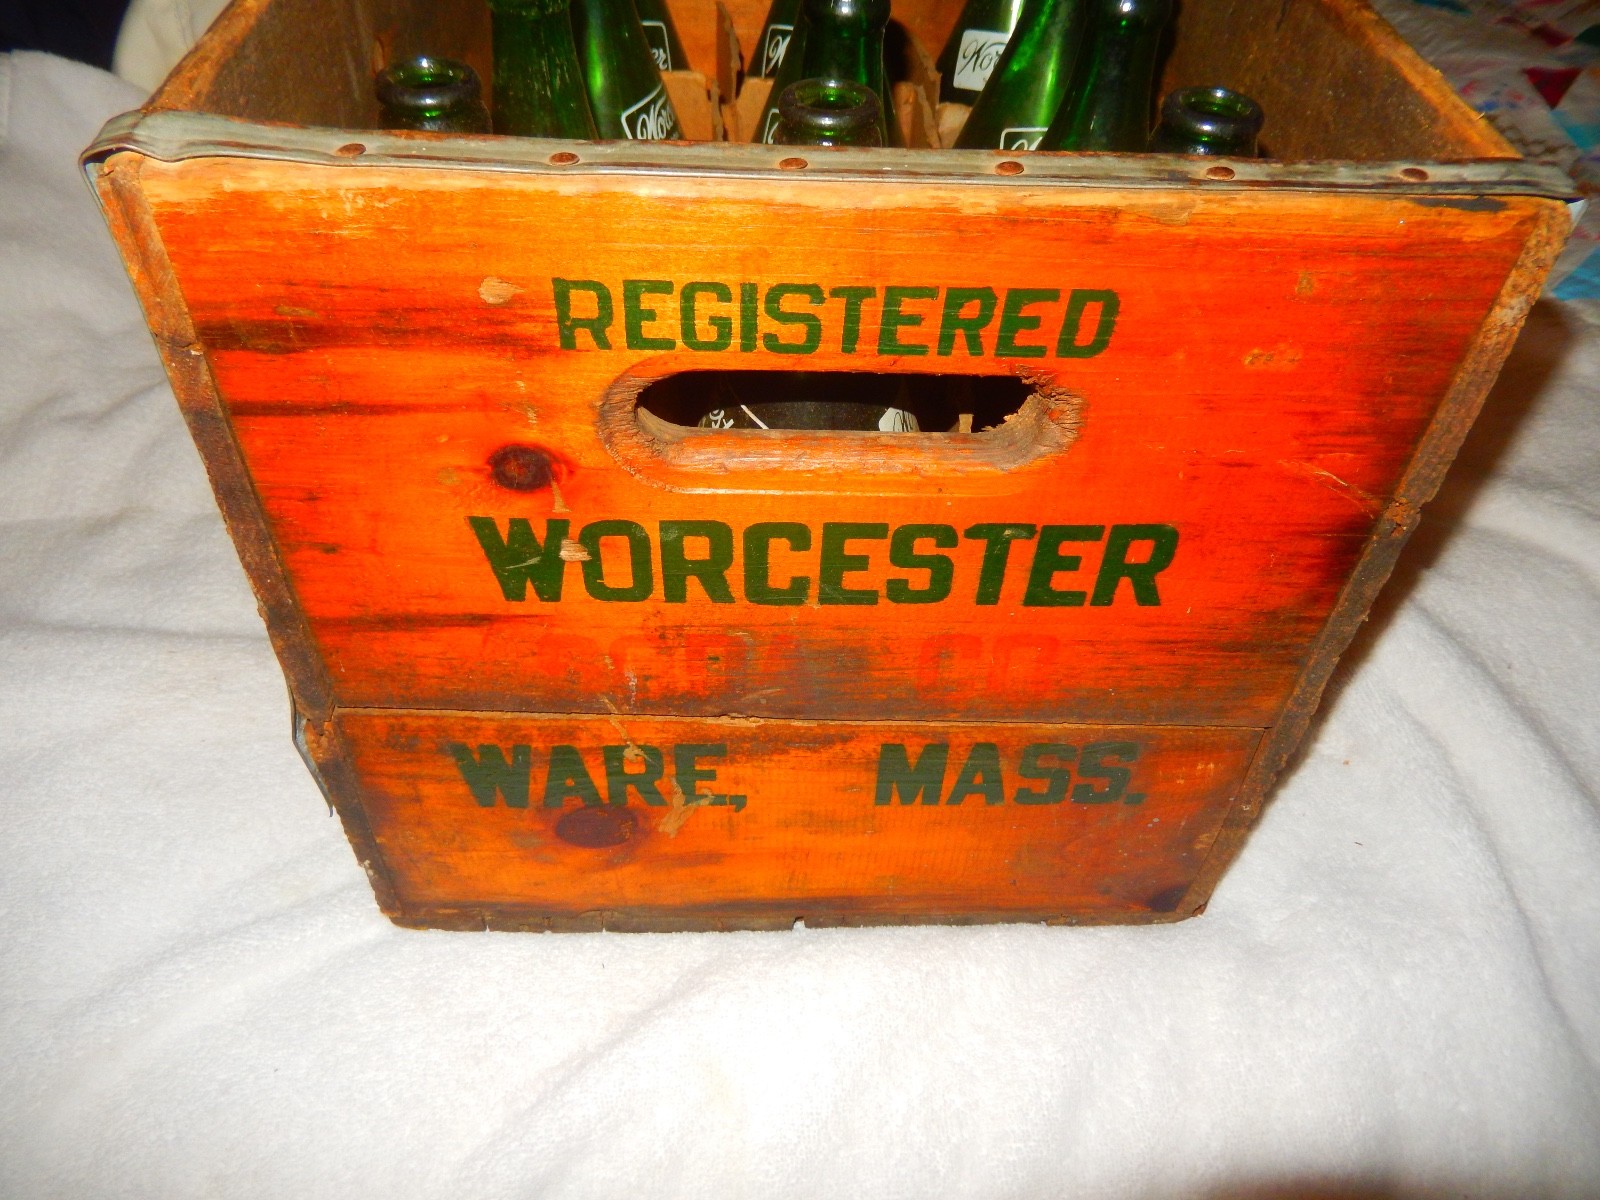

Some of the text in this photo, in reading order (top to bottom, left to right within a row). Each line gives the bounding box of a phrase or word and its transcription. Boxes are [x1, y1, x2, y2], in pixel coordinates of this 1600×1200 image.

[551, 277, 1121, 359] REGISTERED
[467, 514, 1180, 608] WORCESTER
[448, 741, 1146, 814] WARE, MASS.
